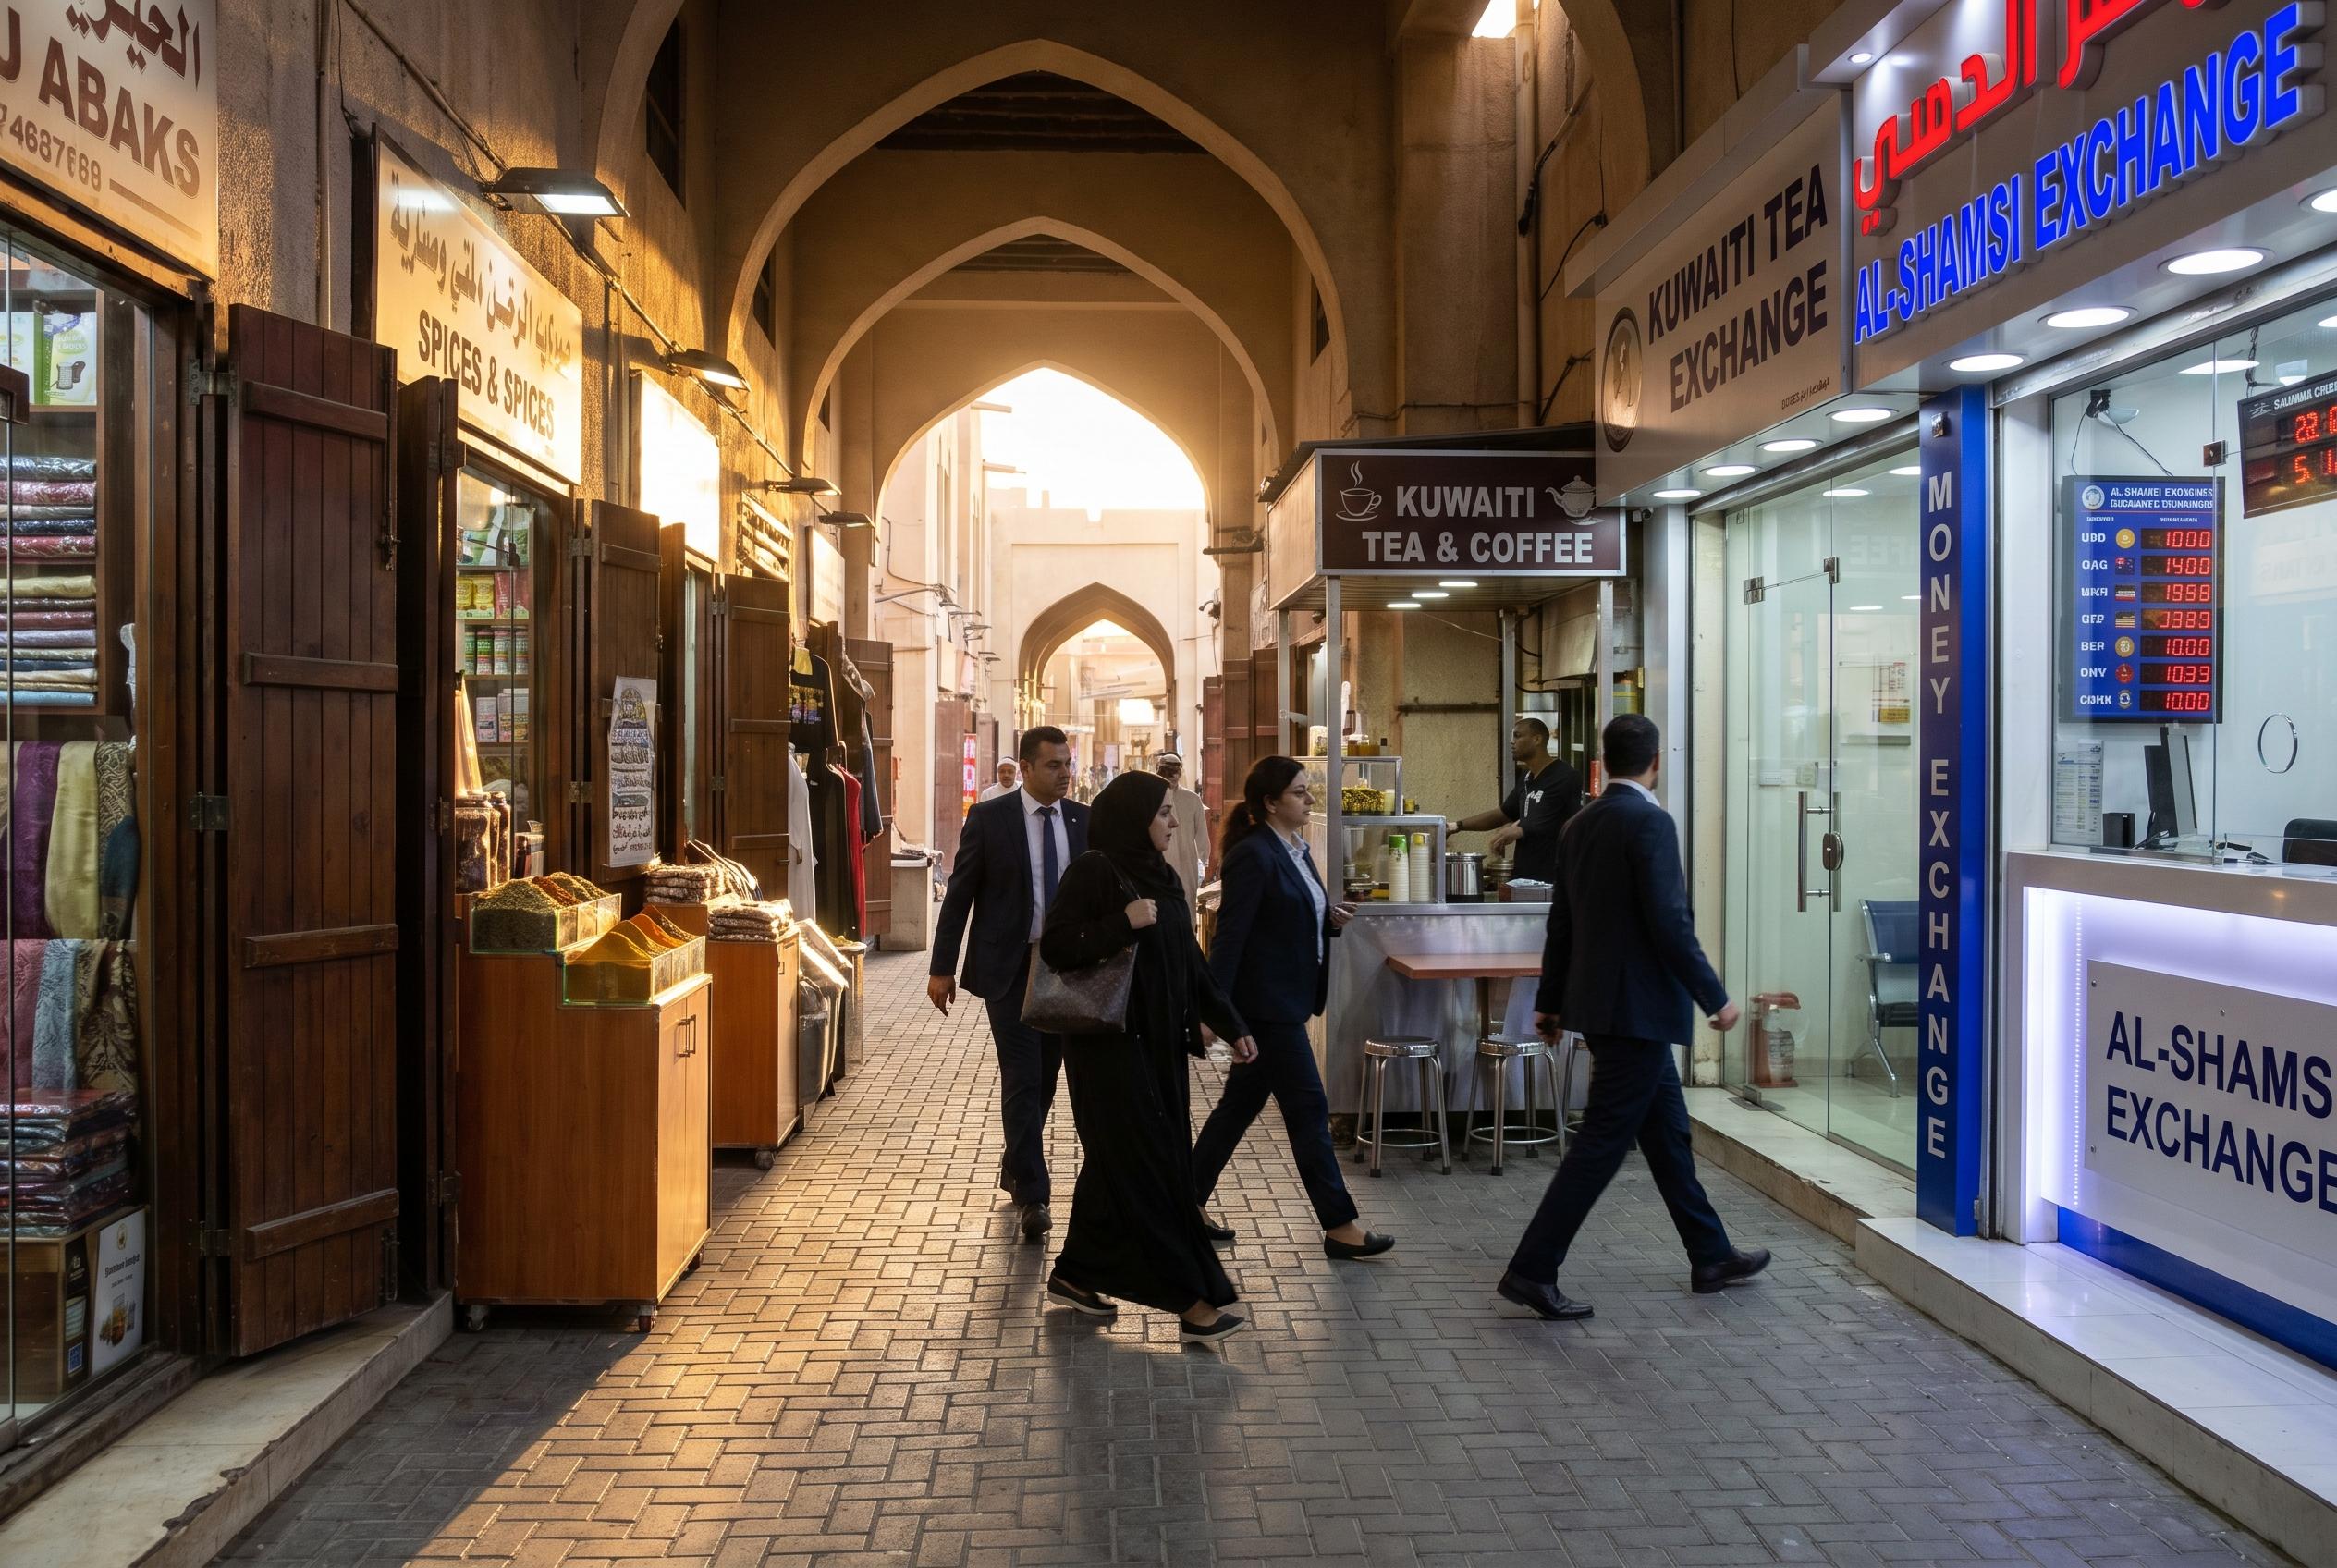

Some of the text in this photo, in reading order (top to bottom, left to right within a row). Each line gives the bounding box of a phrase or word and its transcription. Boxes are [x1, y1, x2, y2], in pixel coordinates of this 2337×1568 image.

[38, 36, 200, 197] ABAKS
[1854, 173, 2021, 345] AL-SHAMSI
[2035, 2, 2299, 251] EXCHANGE
[1648, 163, 1828, 346] KUWAITI TEA
[418, 309, 482, 396] SPICES
[487, 355, 498, 407] &
[504, 367, 555, 441] SPICES
[1670, 259, 1828, 413] EXCHANGE
[1362, 531, 1594, 564] TEA & COFFEE
[1396, 485, 1535, 519] KUWAITI
[1927, 471, 1952, 715] MONEY
[1926, 758, 1951, 1159] EXCHANGE
[2106, 1011, 2333, 1120] AL-SHAMS
[2107, 1084, 2337, 1215] EXCHANGE
